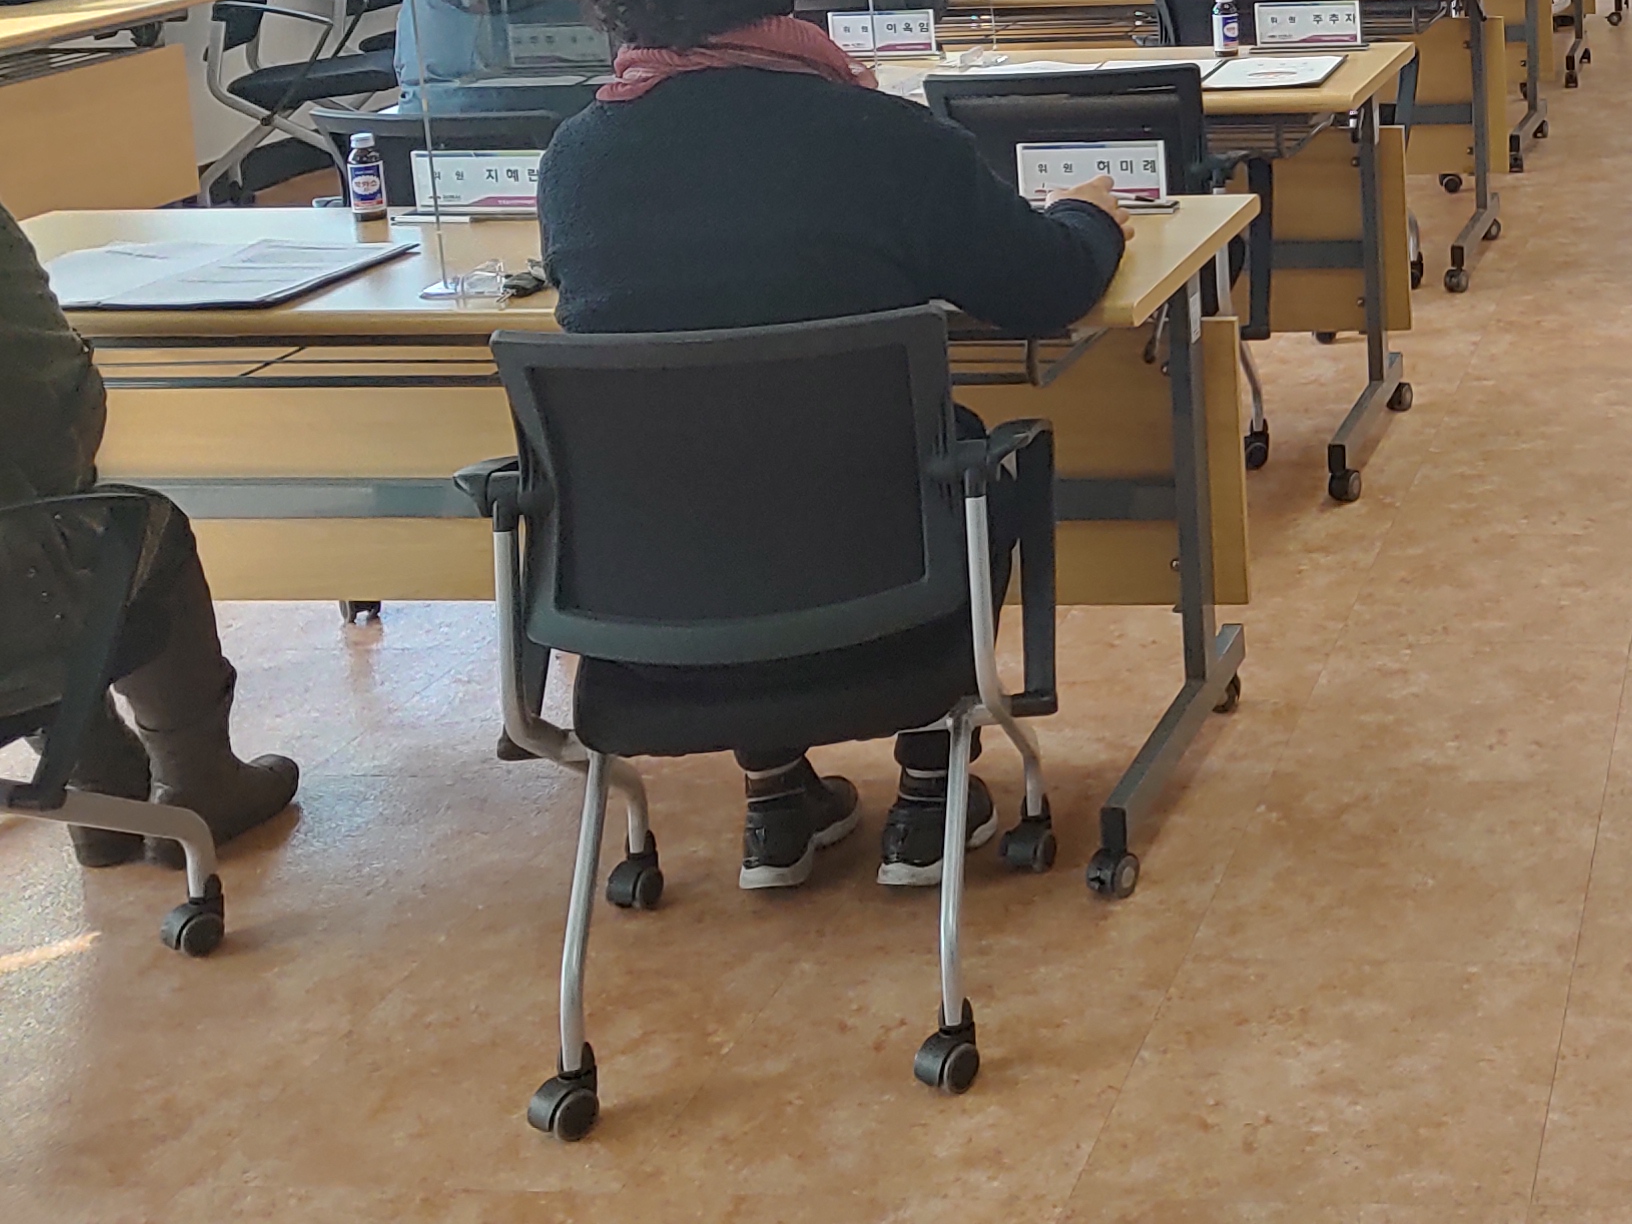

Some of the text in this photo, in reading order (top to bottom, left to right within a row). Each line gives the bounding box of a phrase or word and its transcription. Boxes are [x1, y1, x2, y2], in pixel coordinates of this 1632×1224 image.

[1312, 13, 1356, 25] 주추자
[886, 22, 930, 34] 이옥임
[1096, 159, 1157, 175] 허미례
